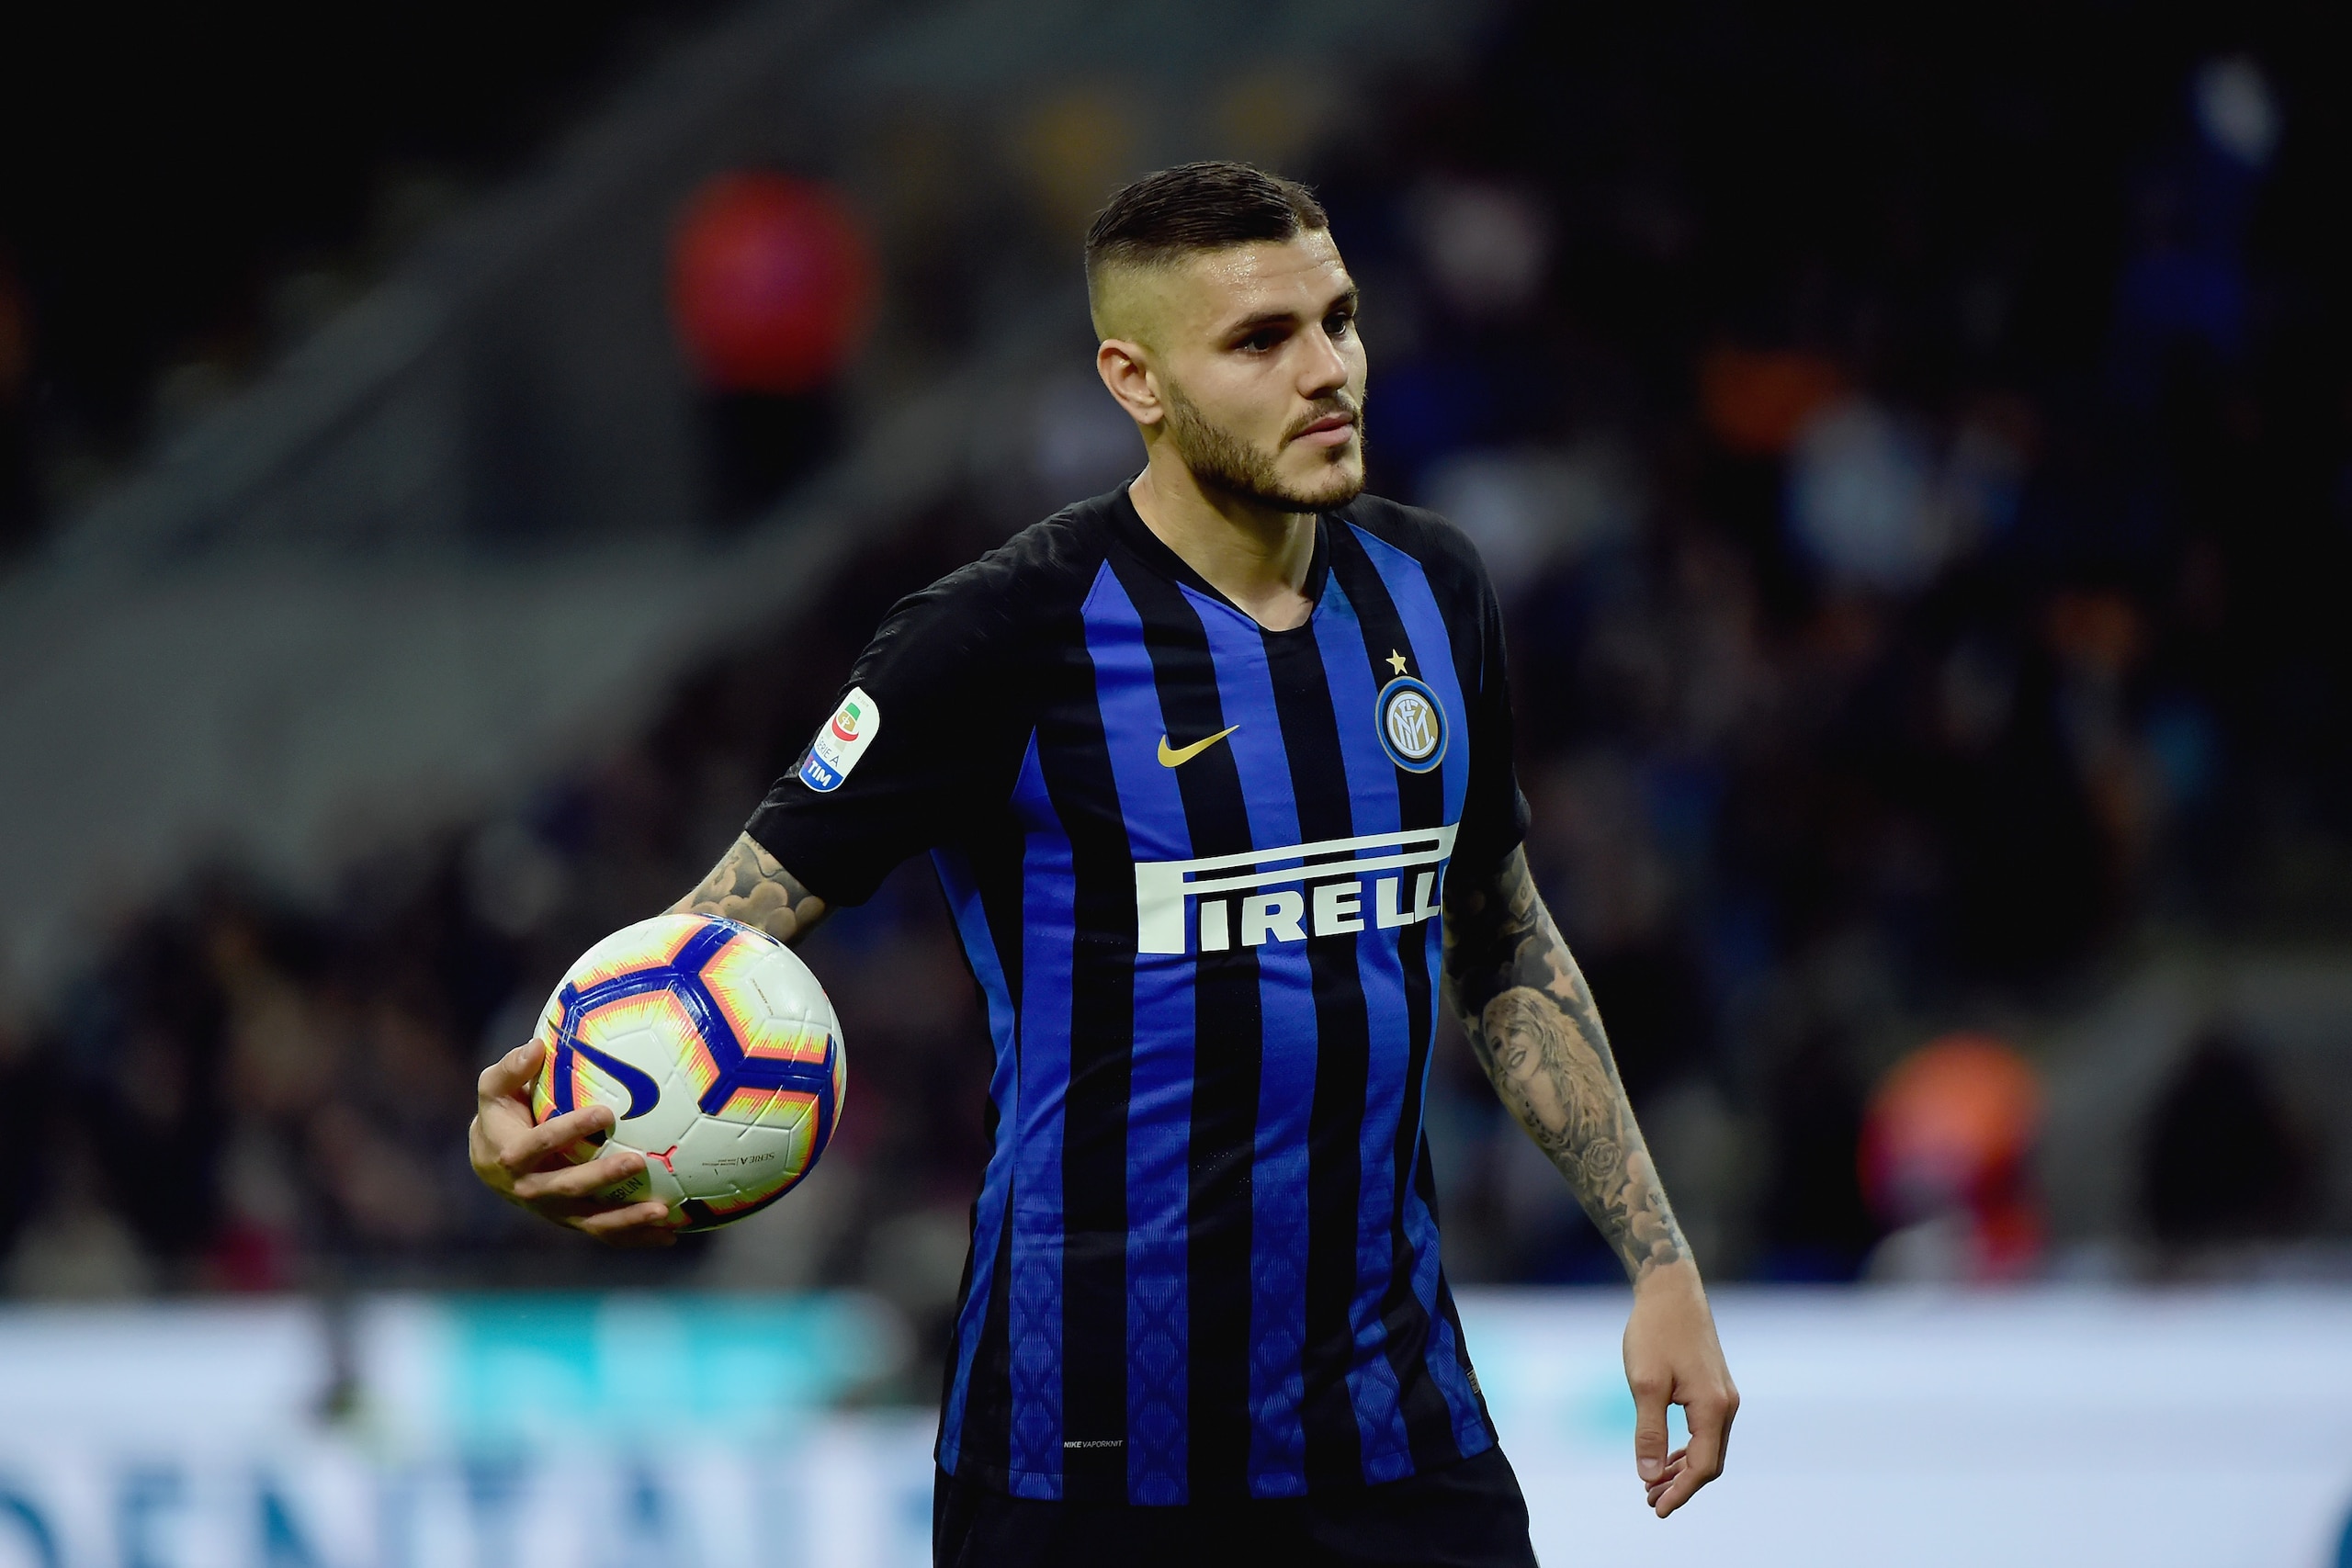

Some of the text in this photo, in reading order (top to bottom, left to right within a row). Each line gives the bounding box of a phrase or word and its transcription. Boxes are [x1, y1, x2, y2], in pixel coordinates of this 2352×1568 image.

[830, 754, 840, 768] A
[807, 760, 832, 787] TIM
[1134, 822, 1460, 954] PIRELL
[740, 1156, 748, 1166] A
[749, 1152, 775, 1164] SERIE
[1082, 1440, 1123, 1449] VAPORKNIT
